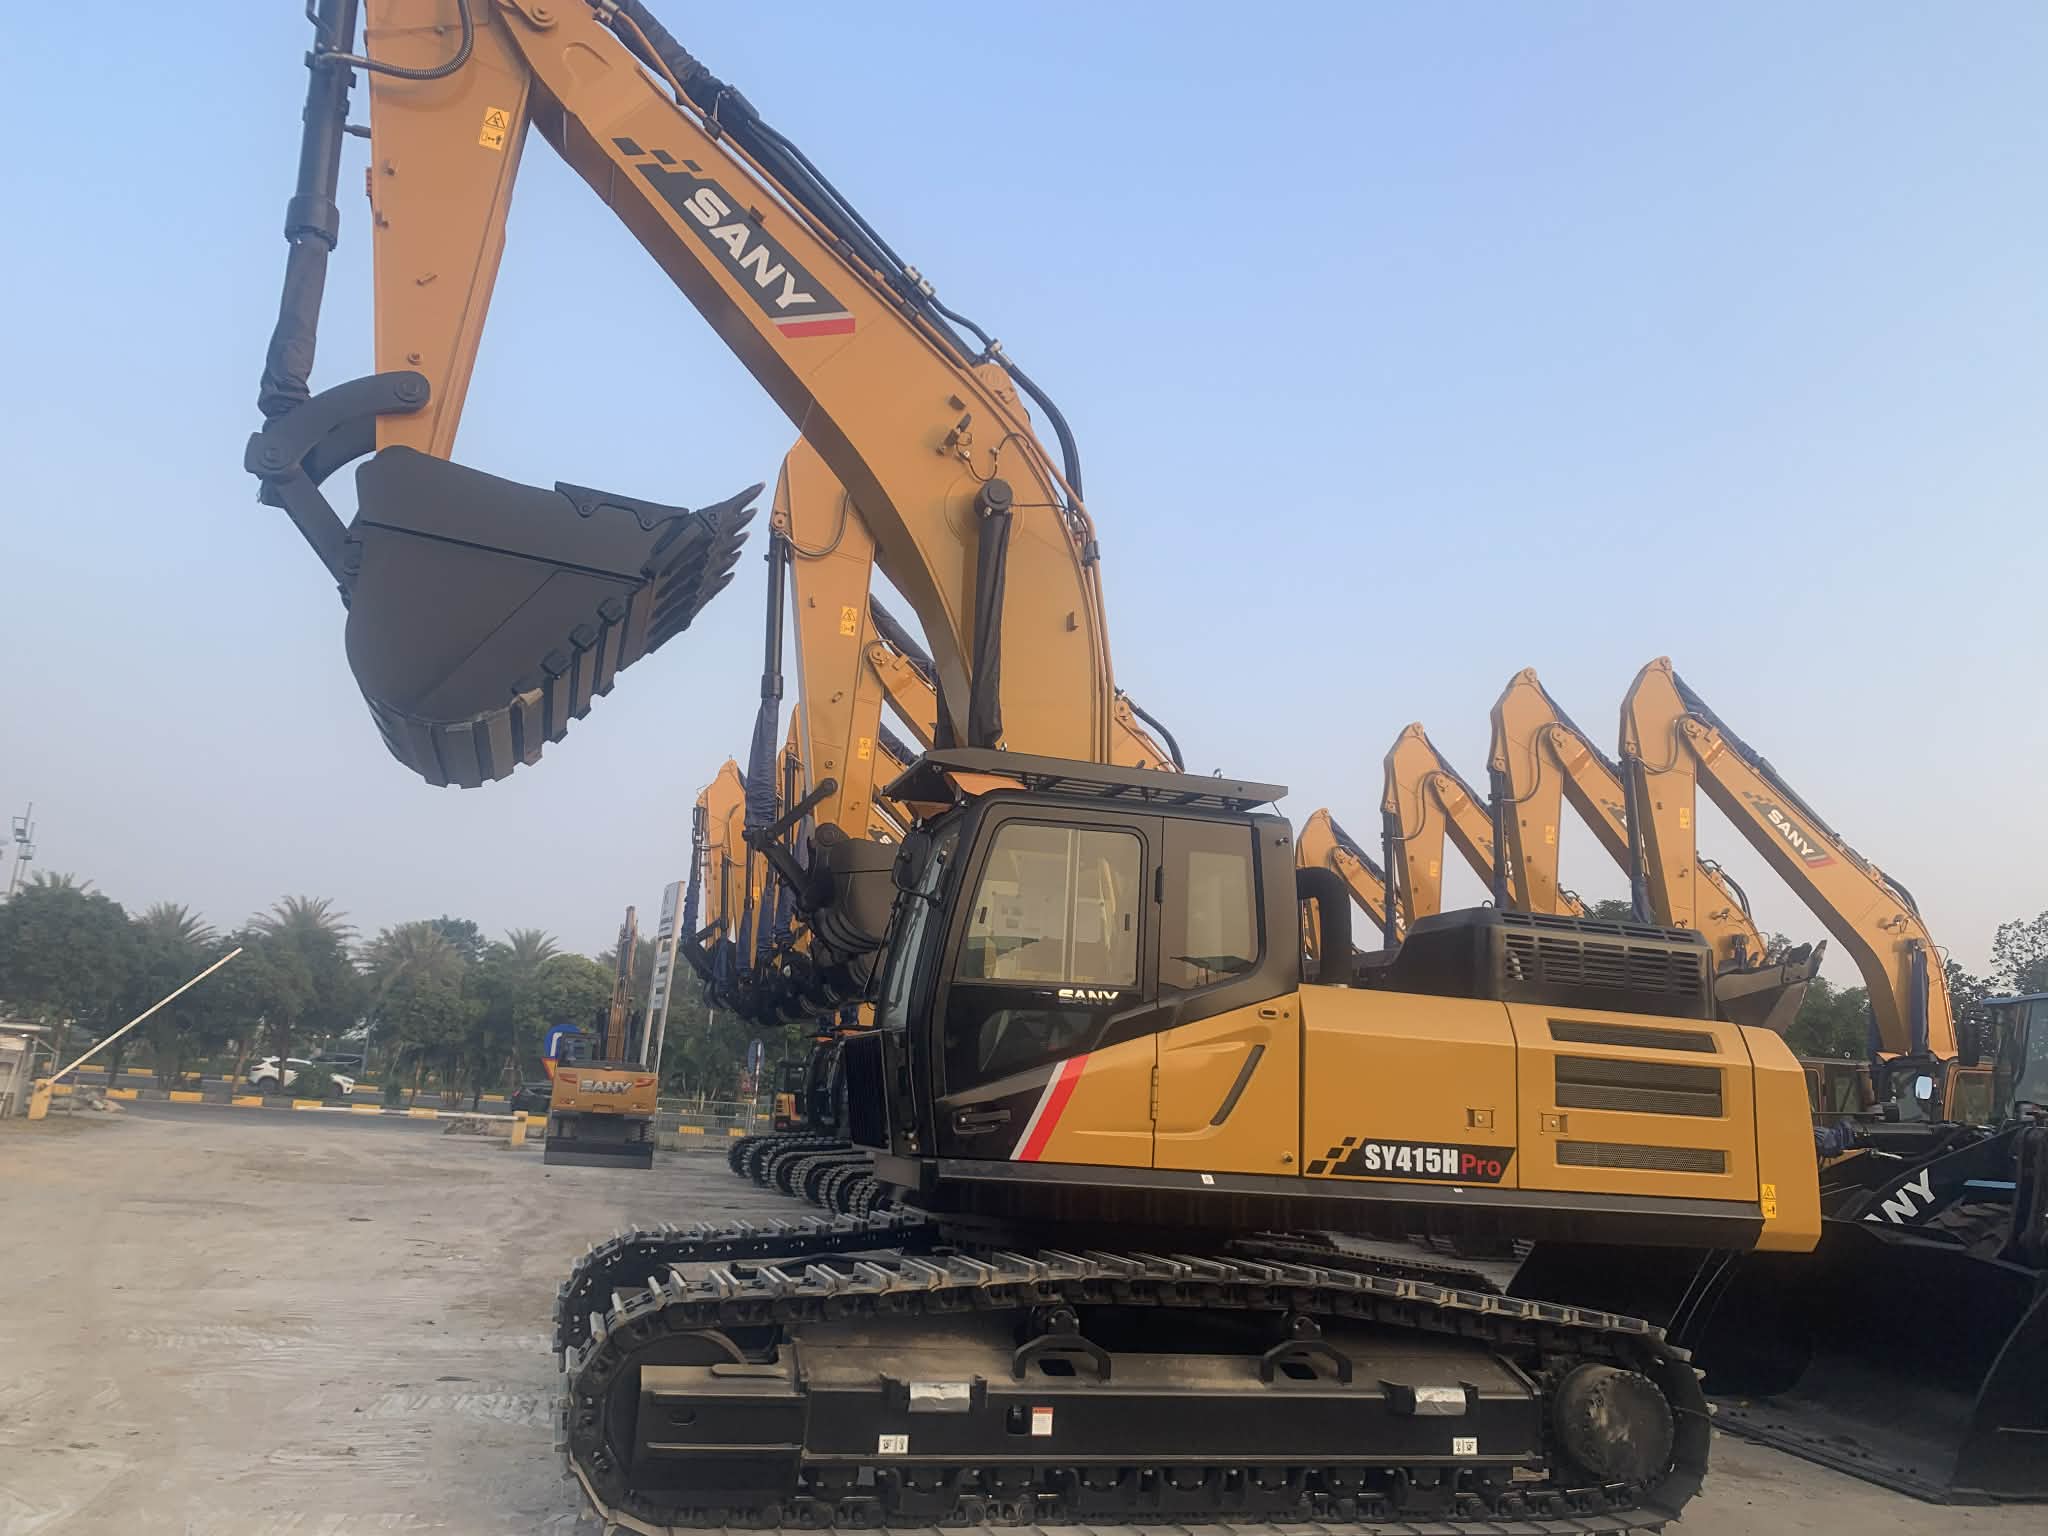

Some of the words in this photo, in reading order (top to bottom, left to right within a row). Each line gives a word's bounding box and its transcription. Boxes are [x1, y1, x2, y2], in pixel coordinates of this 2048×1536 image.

[683, 187, 816, 309] SANY
[1767, 809, 1815, 856] SANY
[1058, 988, 1120, 1004] SANY
[580, 1080, 632, 1095] SANY
[1365, 1144, 1459, 1175] SY415H
[1461, 1153, 1501, 1177] Pro
